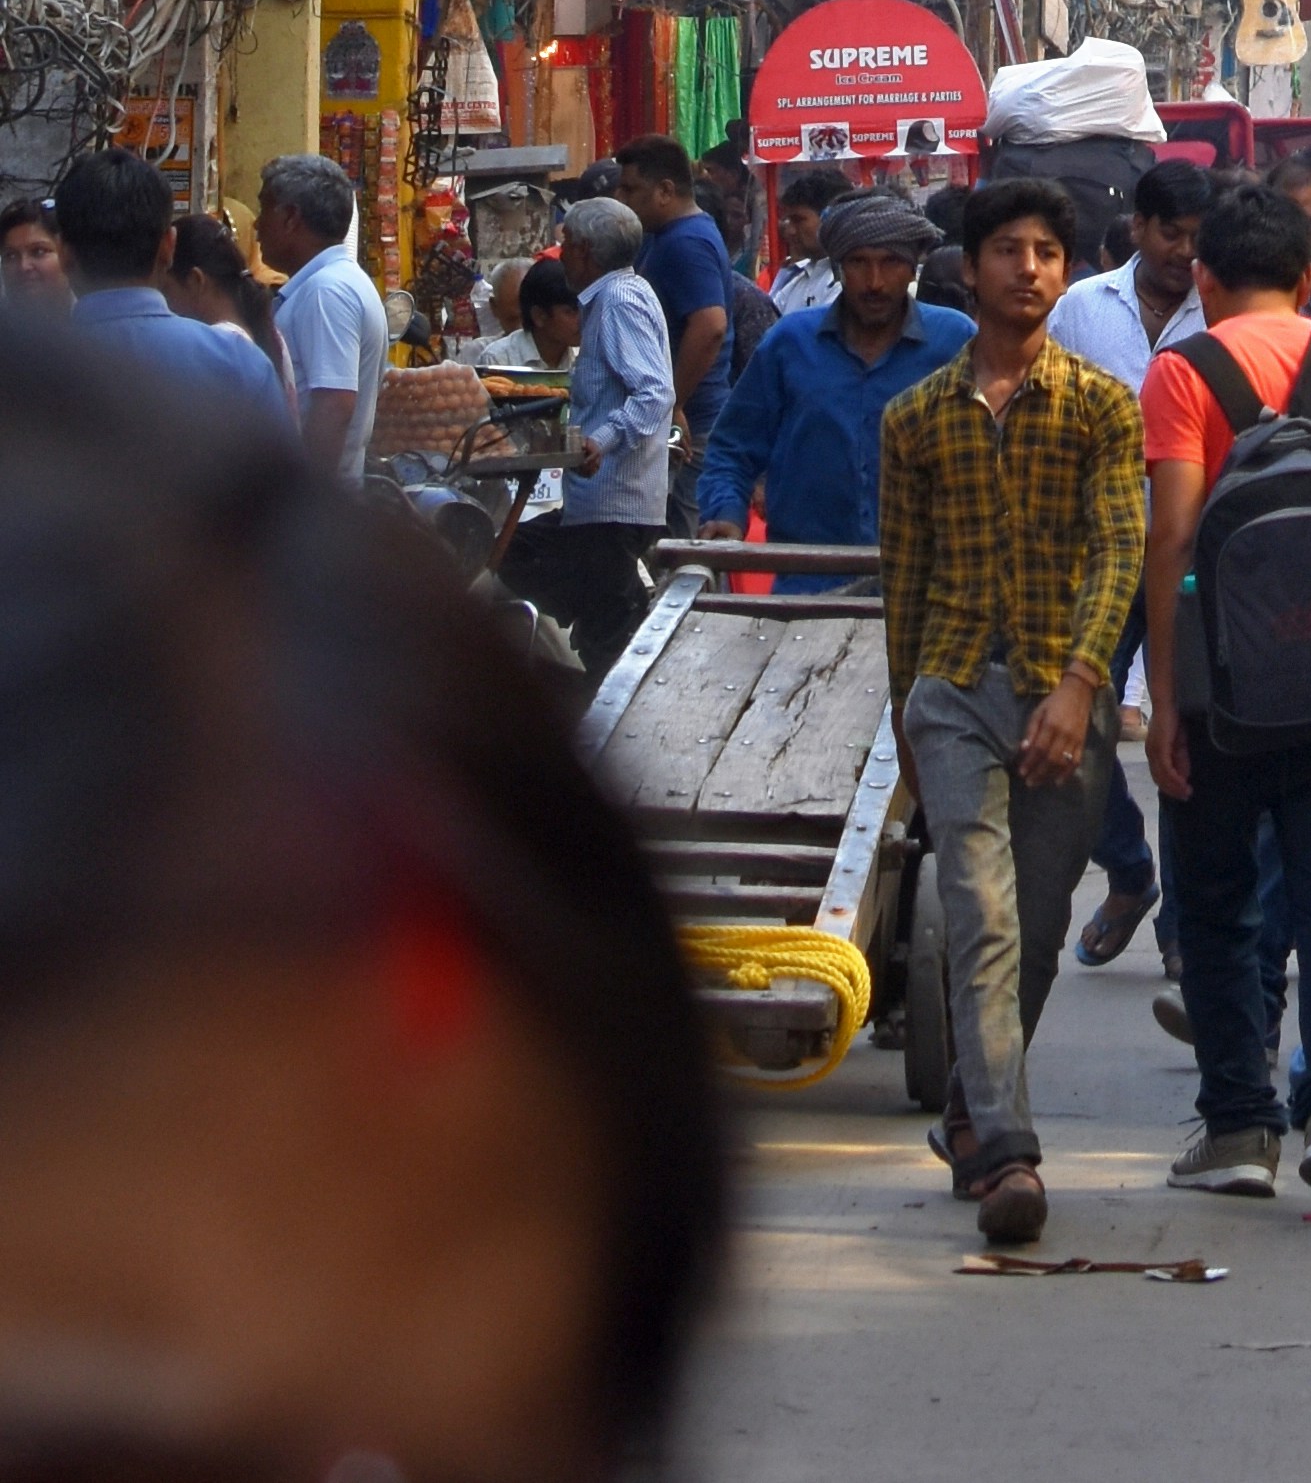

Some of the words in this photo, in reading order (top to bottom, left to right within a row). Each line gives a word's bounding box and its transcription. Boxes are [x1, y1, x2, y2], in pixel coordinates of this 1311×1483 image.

[809, 44, 929, 71] SUPREME
[835, 73, 856, 86] Ice
[858, 72, 903, 85] Cream
[796, 94, 856, 108] ARRANGEMENT
[858, 93, 875, 105] FOR
[876, 91, 920, 105] MARRIAGE
[921, 91, 927, 103] &
[929, 90, 962, 103] PARTIES
[757, 135, 801, 149] SUPREME
[852, 131, 896, 144] SUPREME
